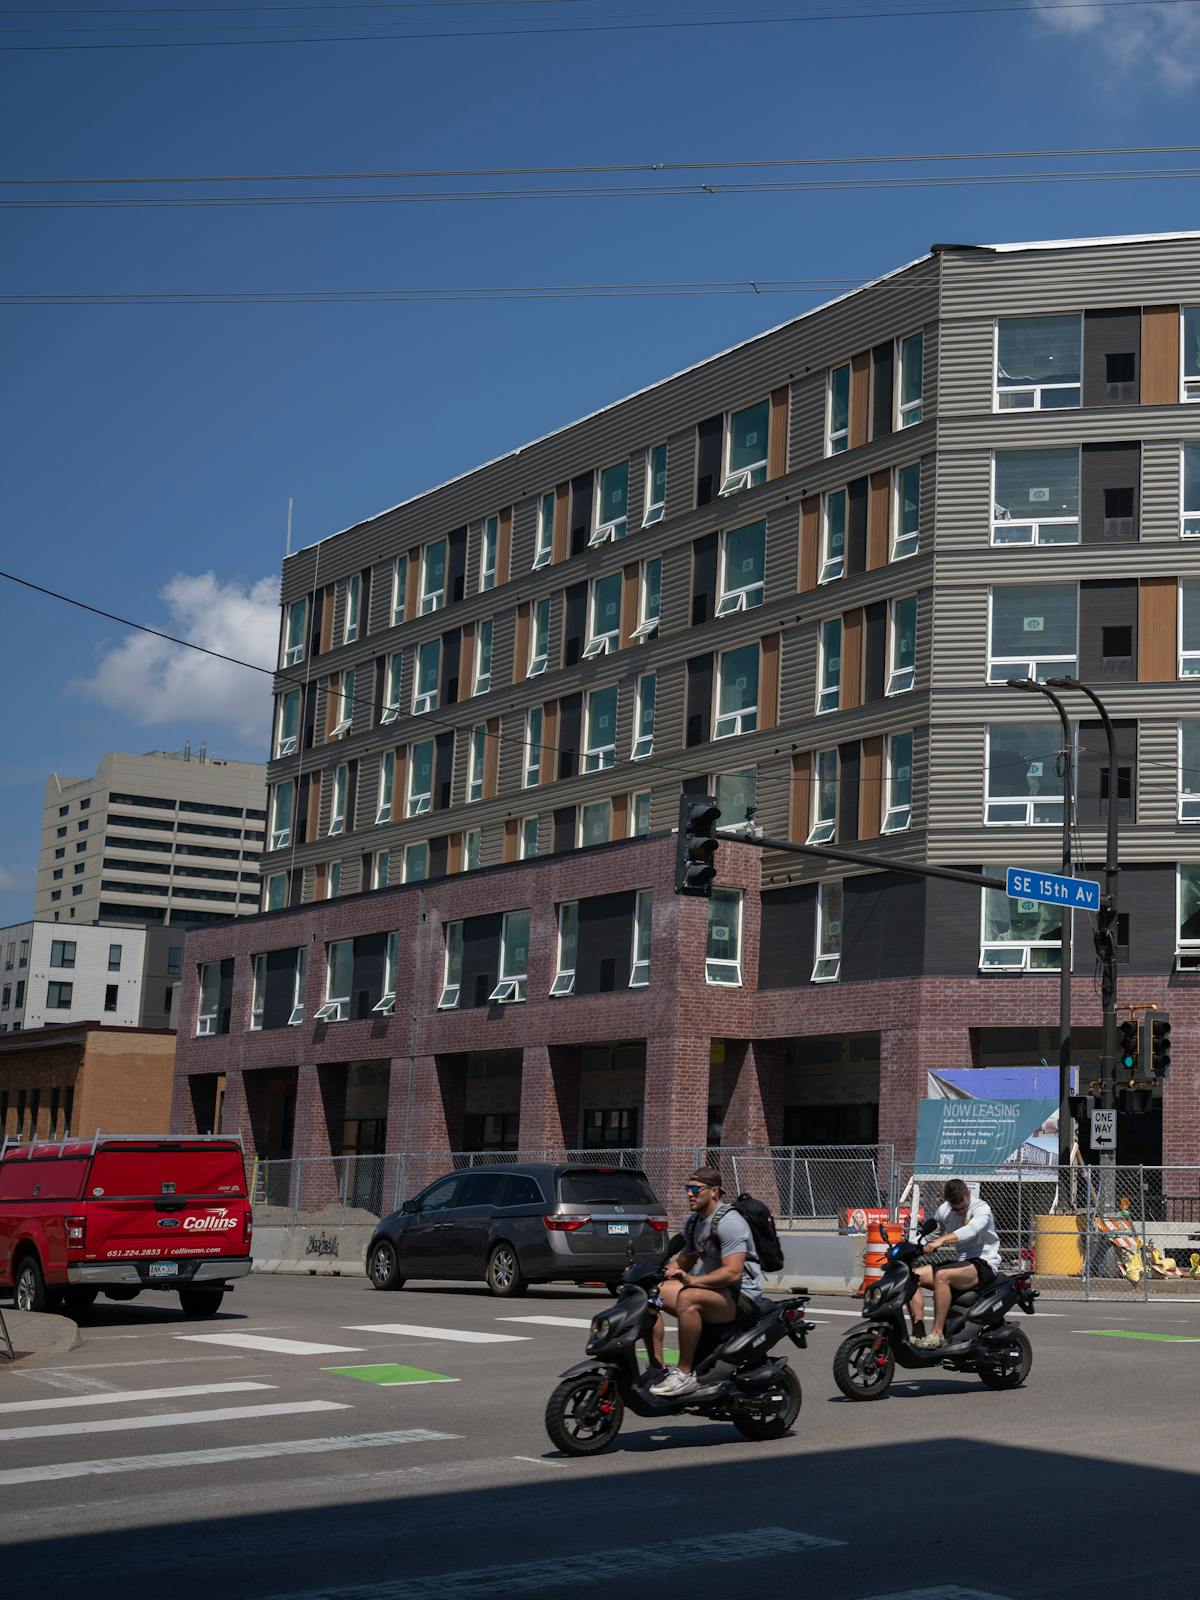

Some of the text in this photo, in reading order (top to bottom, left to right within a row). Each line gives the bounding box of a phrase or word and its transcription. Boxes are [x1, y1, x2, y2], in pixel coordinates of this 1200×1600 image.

[1014, 876, 1093, 903] SE 15th Av
[944, 1104, 1020, 1117] NOW LEASING
[1095, 1112, 1113, 1122] ONE
[1094, 1123, 1113, 1133] WAY
[183, 1215, 238, 1229] Collins
[106, 1248, 161, 1257] 651.224.2833
[170, 1247, 221, 1255] collinsmn.com
